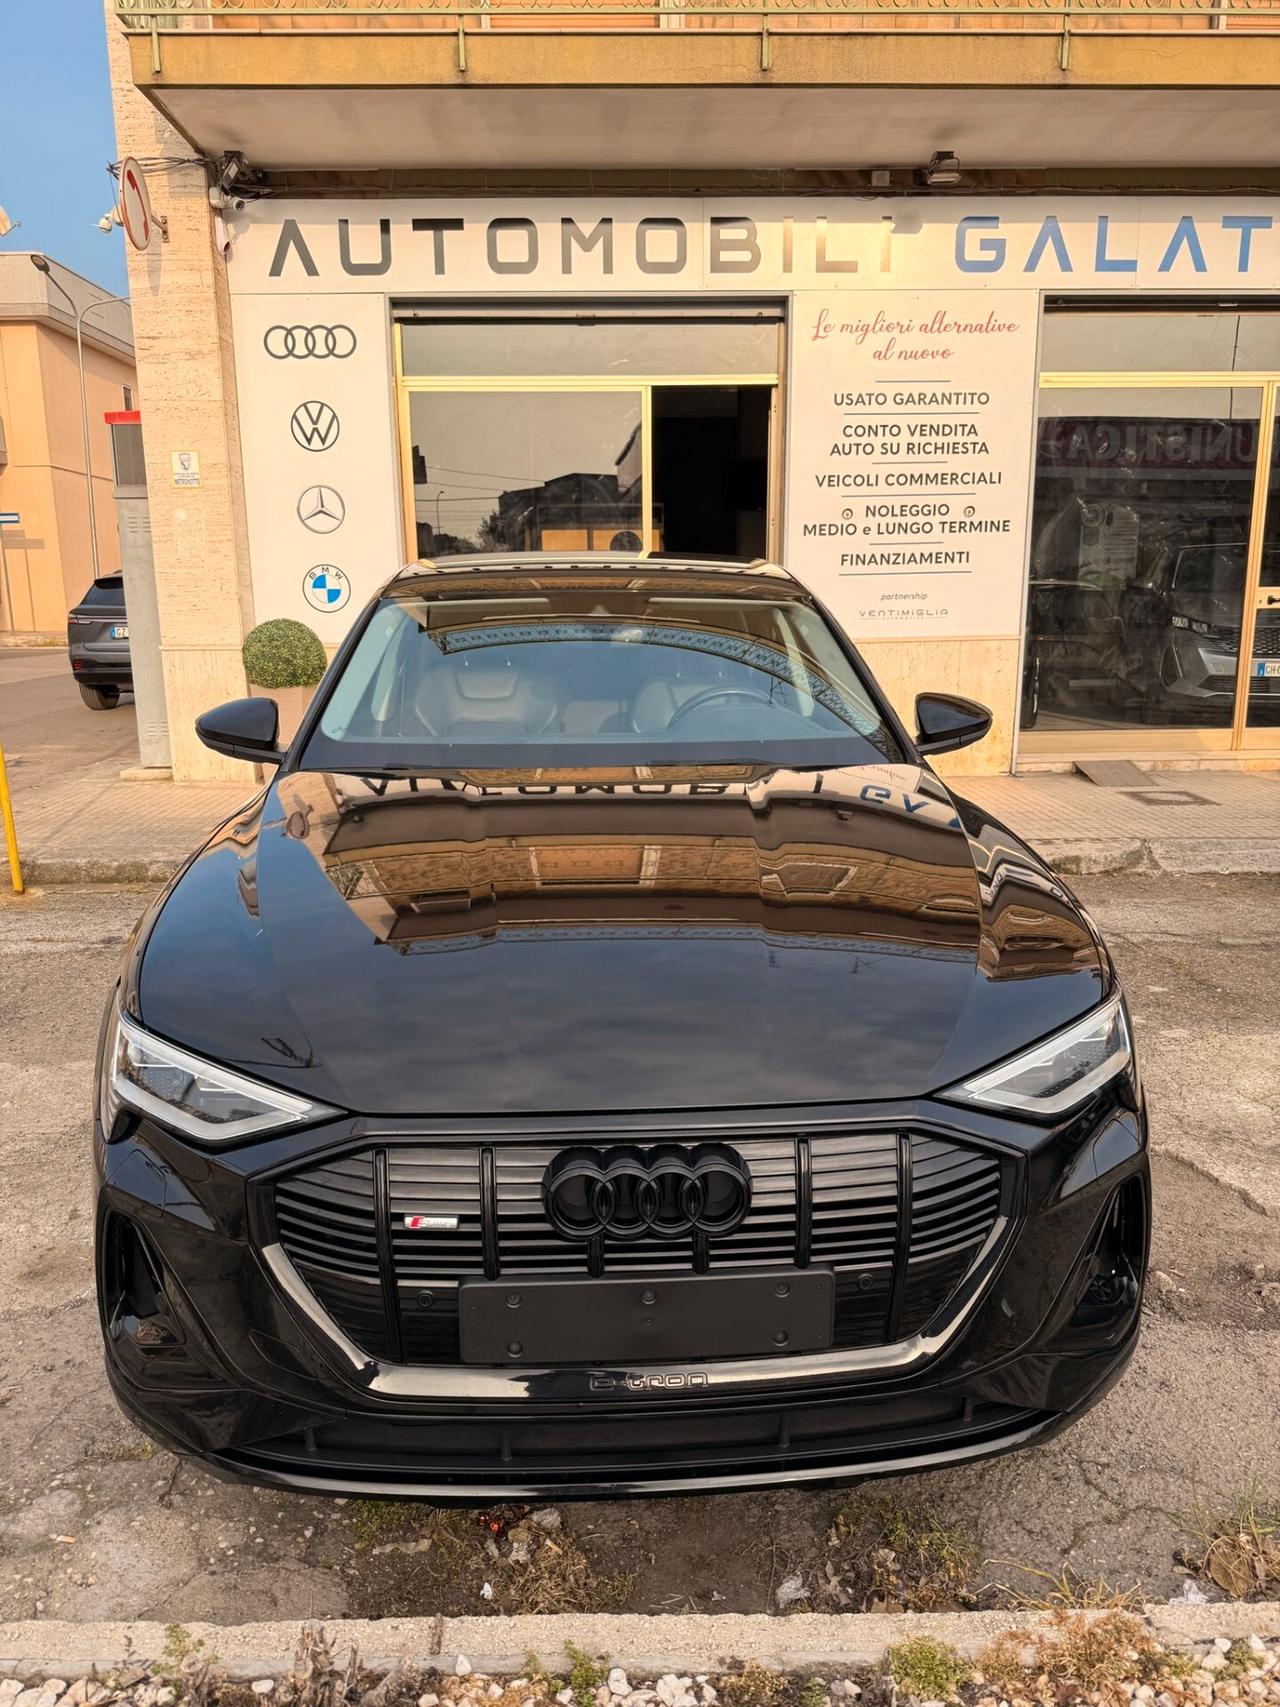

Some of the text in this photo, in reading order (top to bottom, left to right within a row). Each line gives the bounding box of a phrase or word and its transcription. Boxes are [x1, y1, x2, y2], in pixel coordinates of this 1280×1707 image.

[269, 216, 891, 277] AUTOMOBILI
[811, 308, 1020, 345] Le migliori alternative
[873, 337, 954, 361] al nuovo
[834, 392, 990, 406] USATO GARANTITO
[842, 424, 978, 438] CONTO VENDITA
[830, 442, 990, 456] AUTO SU RICHIESTA
[815, 472, 1002, 487] VEICOLI COMMERCIALI
[865, 504, 950, 518] NOLEGGIO
[803, 520, 1011, 536] MEDIO e LUNGO TERMINE
[841, 551, 970, 566] FINANZIAMENTI
[308, 566, 344, 581] BMW
[880, 592, 928, 601] partnership
[859, 608, 949, 617] VENTIMIGLIA
